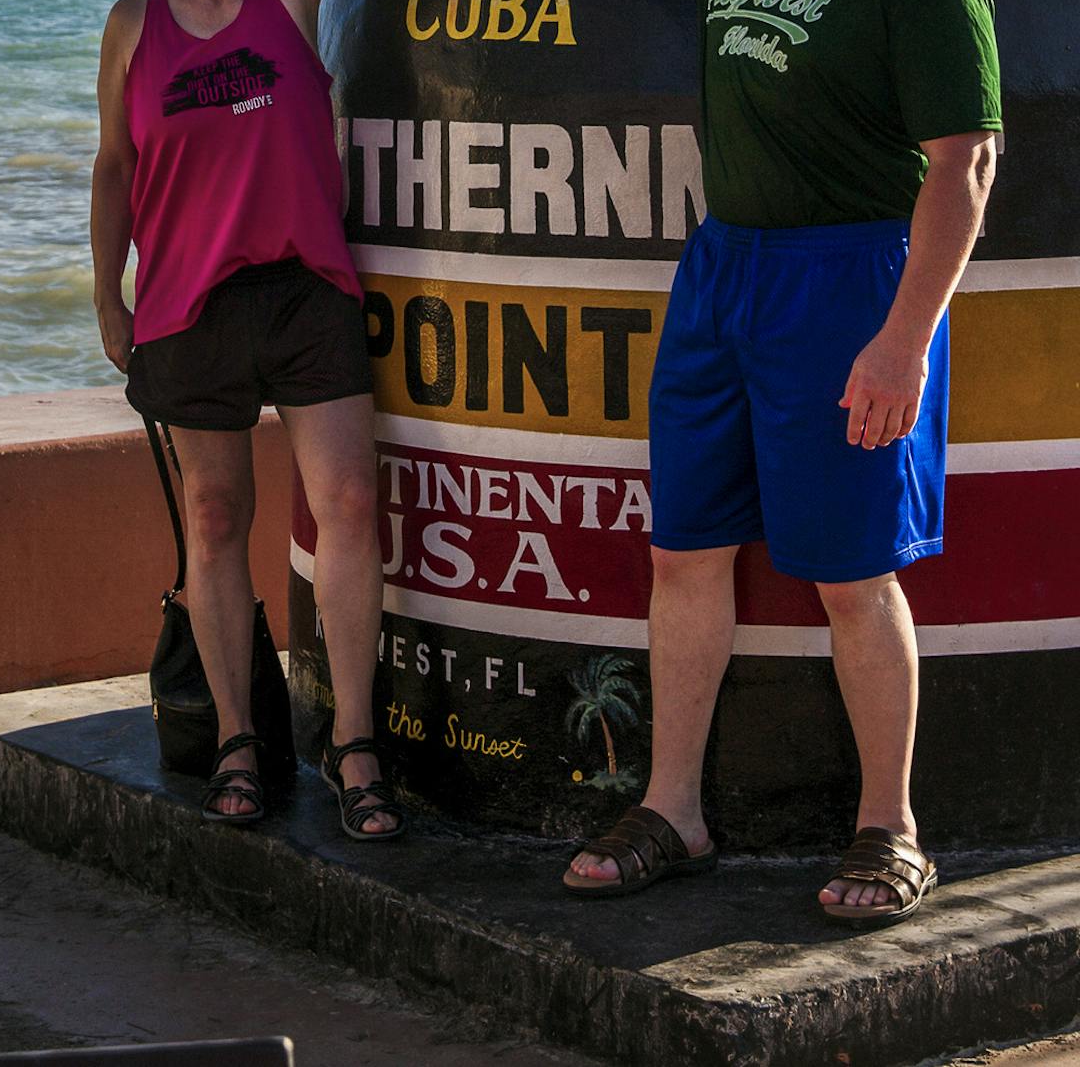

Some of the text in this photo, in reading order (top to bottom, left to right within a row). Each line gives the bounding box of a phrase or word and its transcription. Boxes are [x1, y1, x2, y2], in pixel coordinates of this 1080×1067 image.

[718, 25, 788, 73] Florida
[197, 74, 267, 105] OUTSIDE
[232, 95, 266, 115] ROWDY
[334, 117, 707, 240] THERN
[363, 290, 652, 421] POINT
[376, 453, 653, 533] TINENTA
[386, 701, 527, 760] the Sunset
